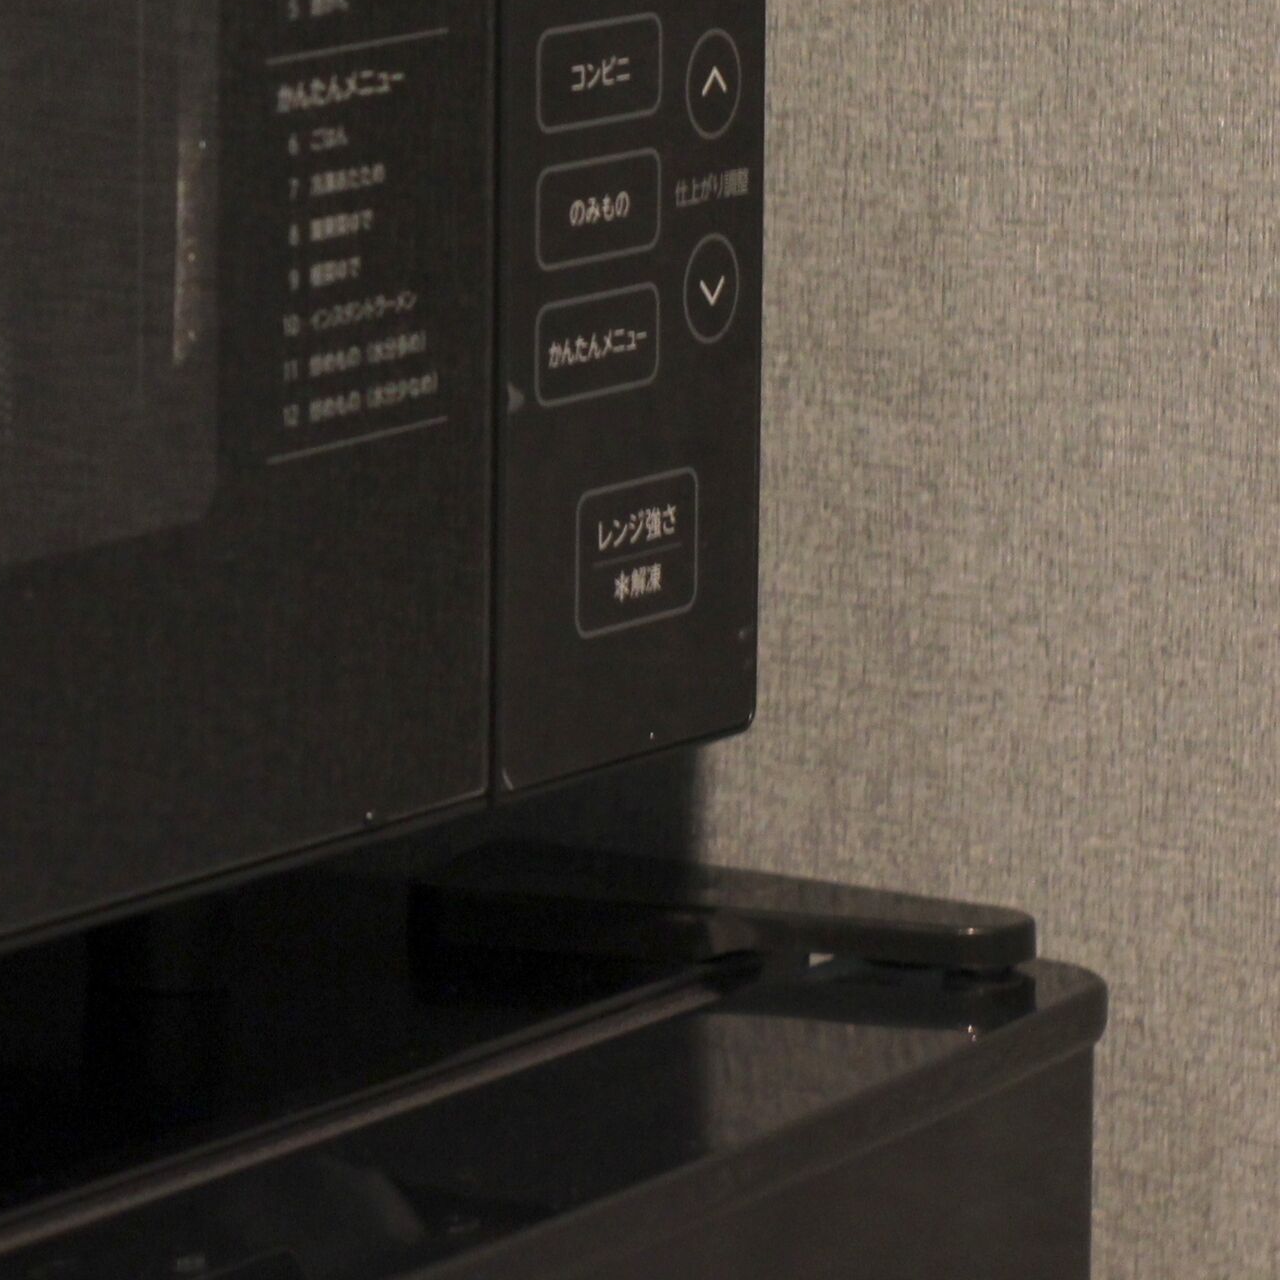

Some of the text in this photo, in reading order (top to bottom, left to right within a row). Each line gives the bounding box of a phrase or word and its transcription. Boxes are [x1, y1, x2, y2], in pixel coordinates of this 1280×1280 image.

[570, 54, 631, 92] コンビニ
[568, 190, 631, 227] のみもの
[548, 328, 648, 369] かんたんメニュー
[598, 502, 678, 552] レンジ強さ
